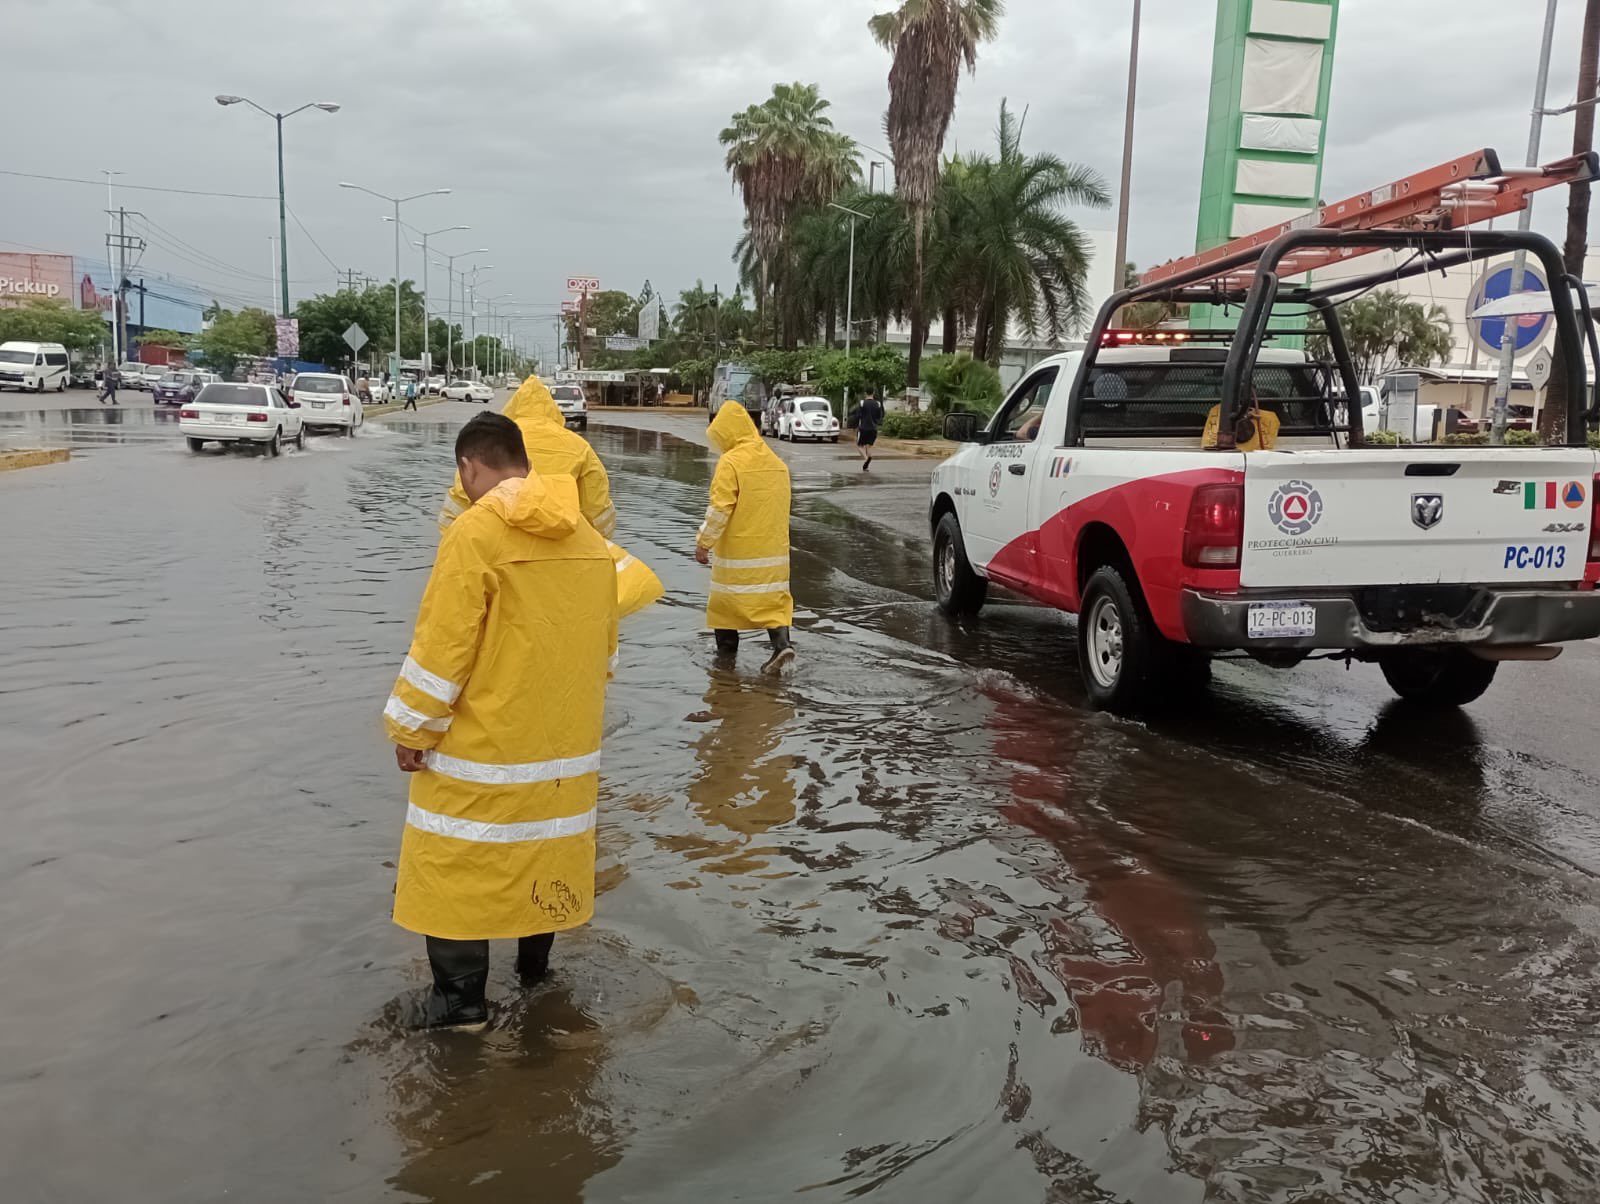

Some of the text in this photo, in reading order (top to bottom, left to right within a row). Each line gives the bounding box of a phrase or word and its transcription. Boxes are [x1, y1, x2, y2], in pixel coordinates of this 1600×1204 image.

[0, 277, 60, 297] Pickup
[569, 280, 598, 289] OXXO
[986, 445, 1025, 458] BOMBEROS
[1314, 536, 1338, 545] CIVIL
[1272, 548, 1312, 557] GUERRERO
[1504, 545, 1566, 569] PC-013
[1252, 610, 1313, 627] 12-PC-013
